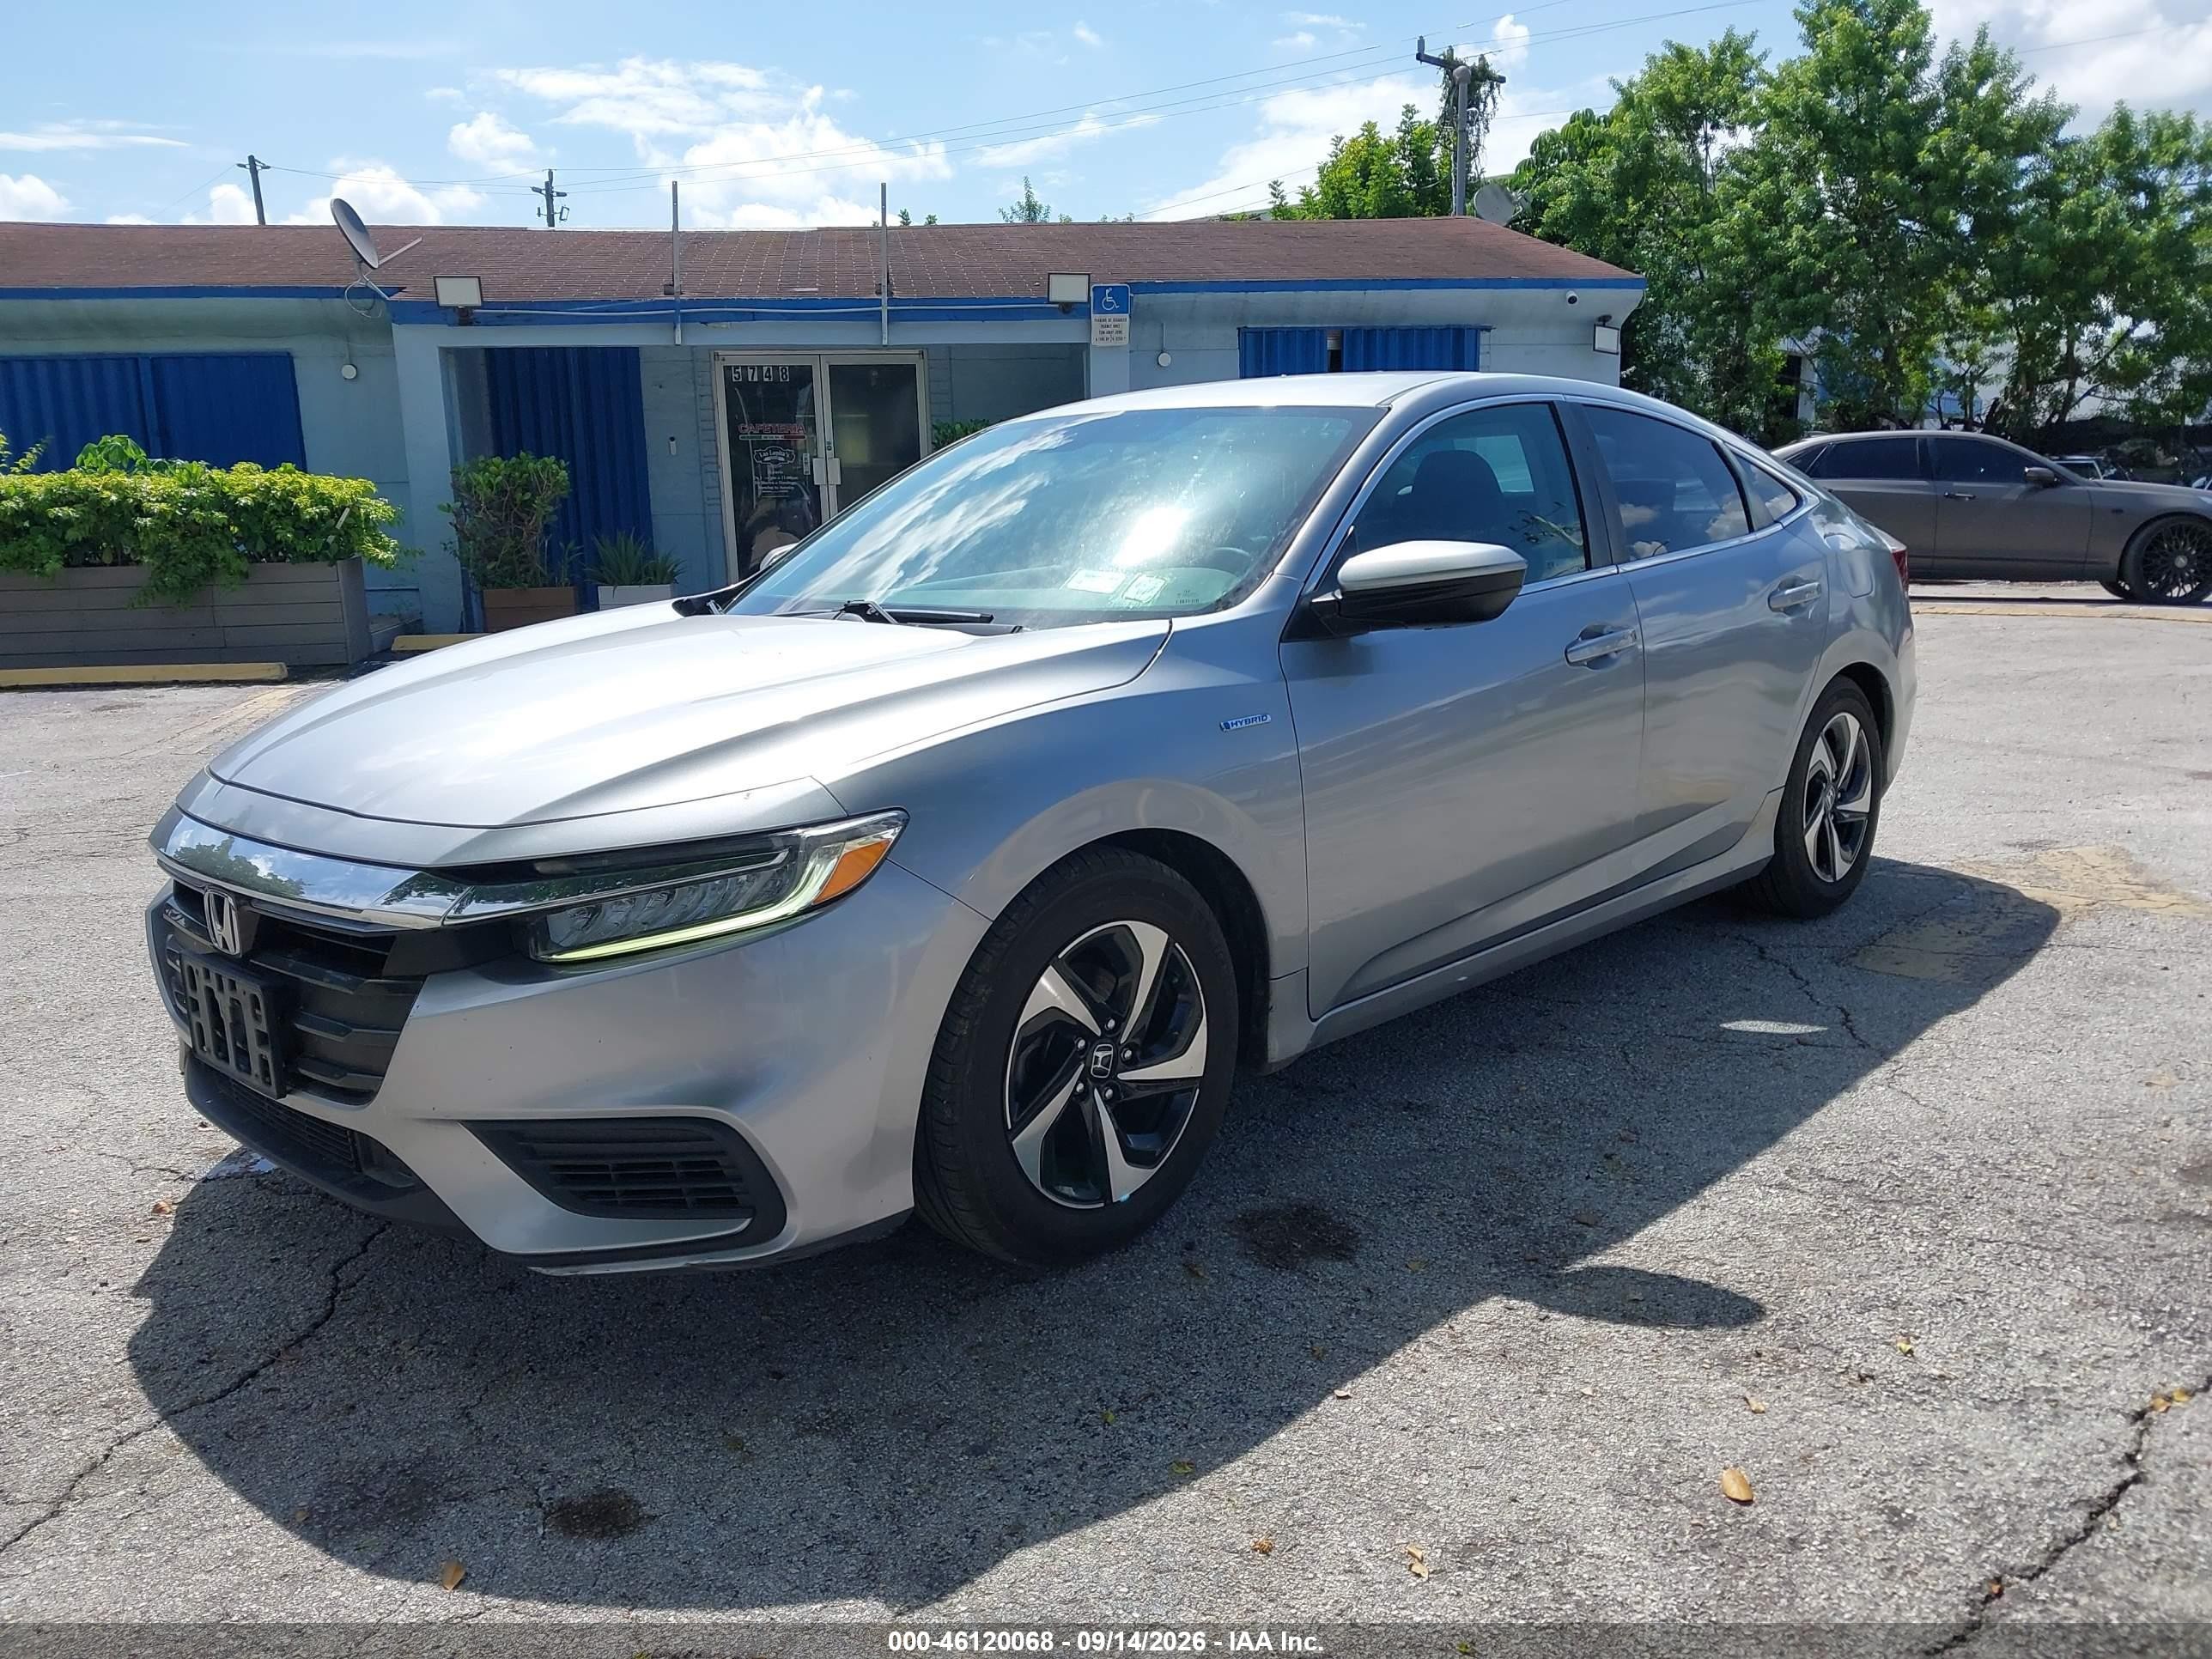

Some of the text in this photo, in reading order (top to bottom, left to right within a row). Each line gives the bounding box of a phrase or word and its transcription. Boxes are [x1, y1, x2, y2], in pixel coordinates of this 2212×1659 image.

[732, 367, 789, 381] 5748
[738, 423, 806, 434] CAFETERIA
[1231, 714, 1267, 727] HYBRID
